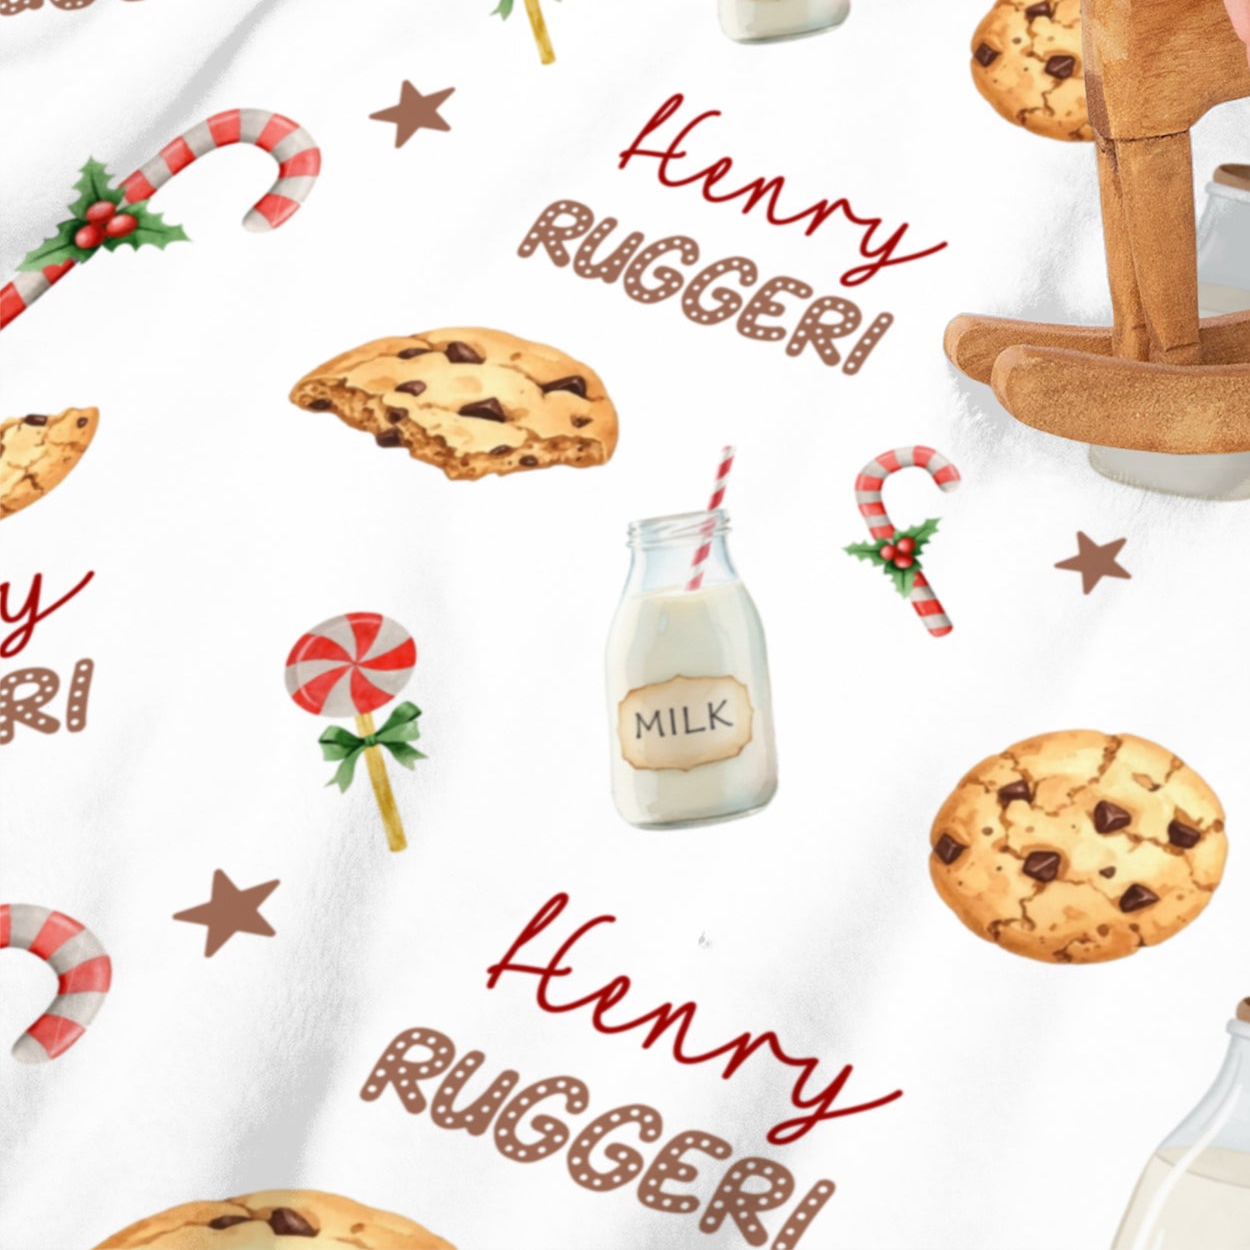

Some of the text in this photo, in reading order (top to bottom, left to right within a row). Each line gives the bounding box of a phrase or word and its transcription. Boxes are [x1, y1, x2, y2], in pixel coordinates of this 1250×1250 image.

[618, 92, 949, 287] Henry
[517, 199, 895, 376] RUGGERI
[634, 699, 734, 740] MILK
[486, 891, 904, 1146] Henry
[359, 1026, 837, 1250] RUGGERI
